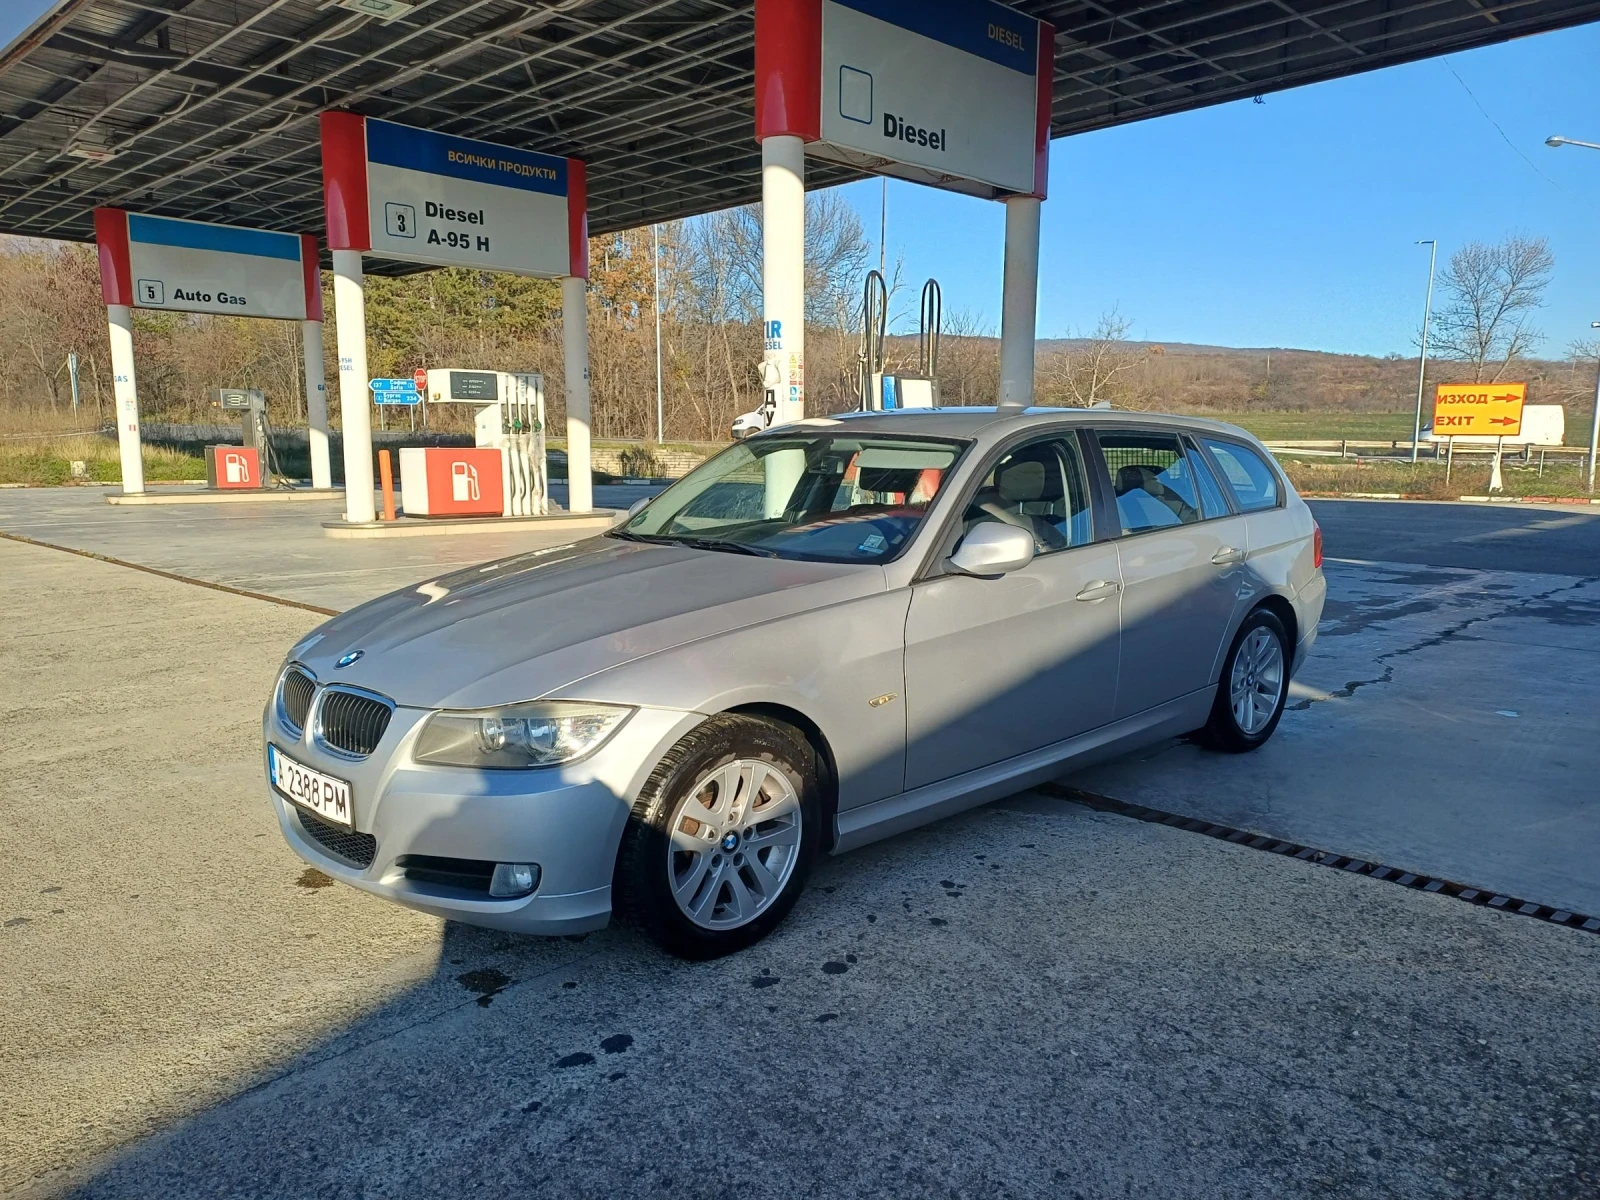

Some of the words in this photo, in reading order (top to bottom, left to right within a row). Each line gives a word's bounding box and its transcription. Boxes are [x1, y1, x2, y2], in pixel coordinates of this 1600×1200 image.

[988, 23, 1025, 51] DIESEL
[883, 112, 946, 152] Diesel
[447, 150, 496, 170] ВСИЧКИ
[498, 160, 557, 180] ПРОДУКТИ
[397, 214, 406, 233] 3
[425, 200, 484, 226] Diesel
[427, 228, 470, 250] A-95
[476, 235, 490, 252] H
[147, 285, 155, 300] 5
[173, 288, 212, 303] Auto
[216, 291, 247, 306] Gas
[1437, 393, 1488, 405] ИЗХОД
[1435, 416, 1475, 426] EXIT
[287, 765, 320, 808] 2388
[323, 781, 347, 819] PM
